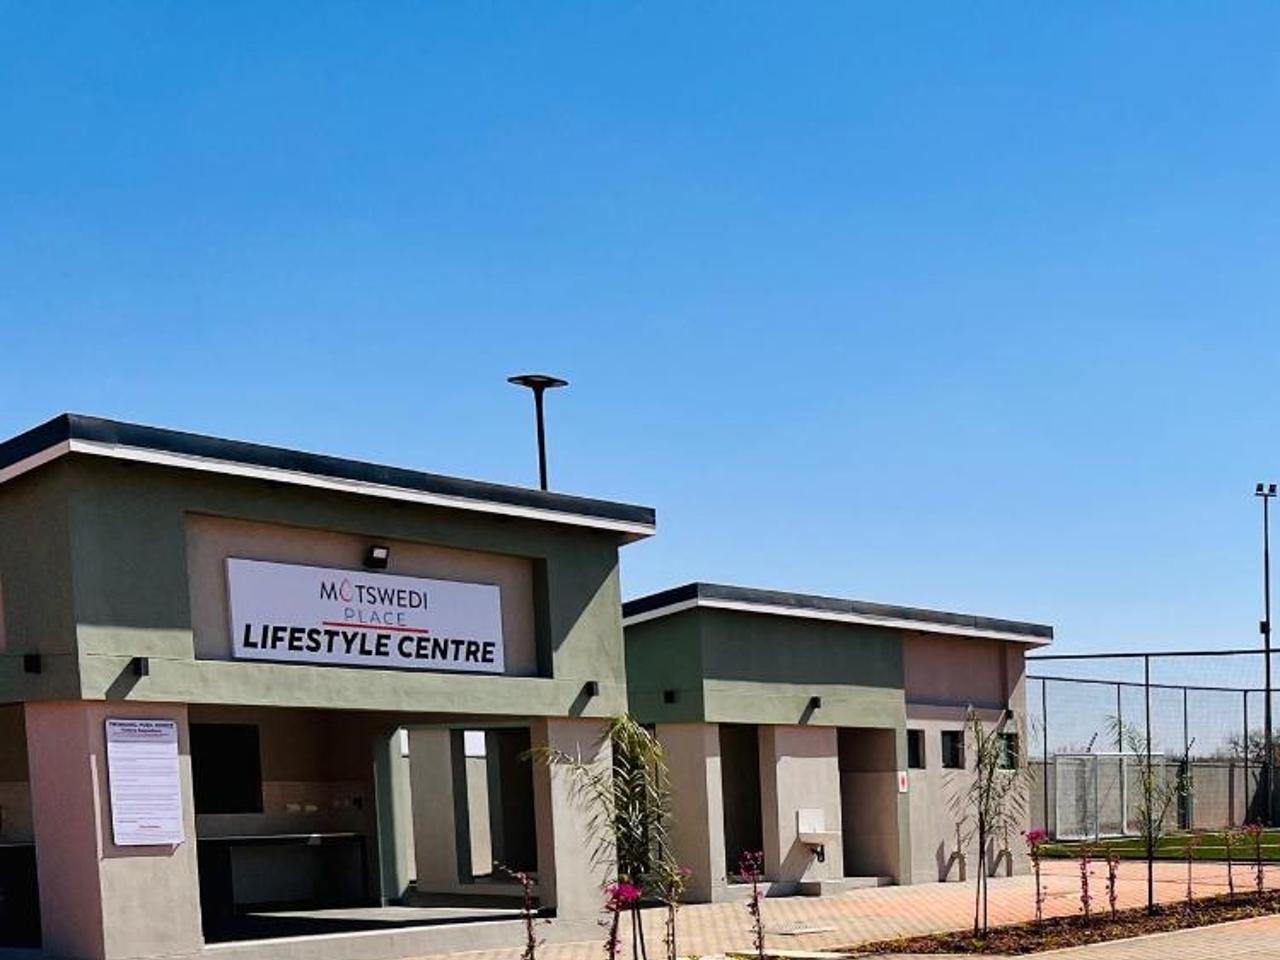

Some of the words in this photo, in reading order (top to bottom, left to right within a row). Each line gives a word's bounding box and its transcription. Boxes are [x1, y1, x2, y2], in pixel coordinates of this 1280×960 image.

[320, 579, 428, 610] MOTSWEDI
[344, 607, 407, 627] PLACE
[243, 624, 391, 656] LIFESTYLE
[397, 636, 495, 663] CENTRE
